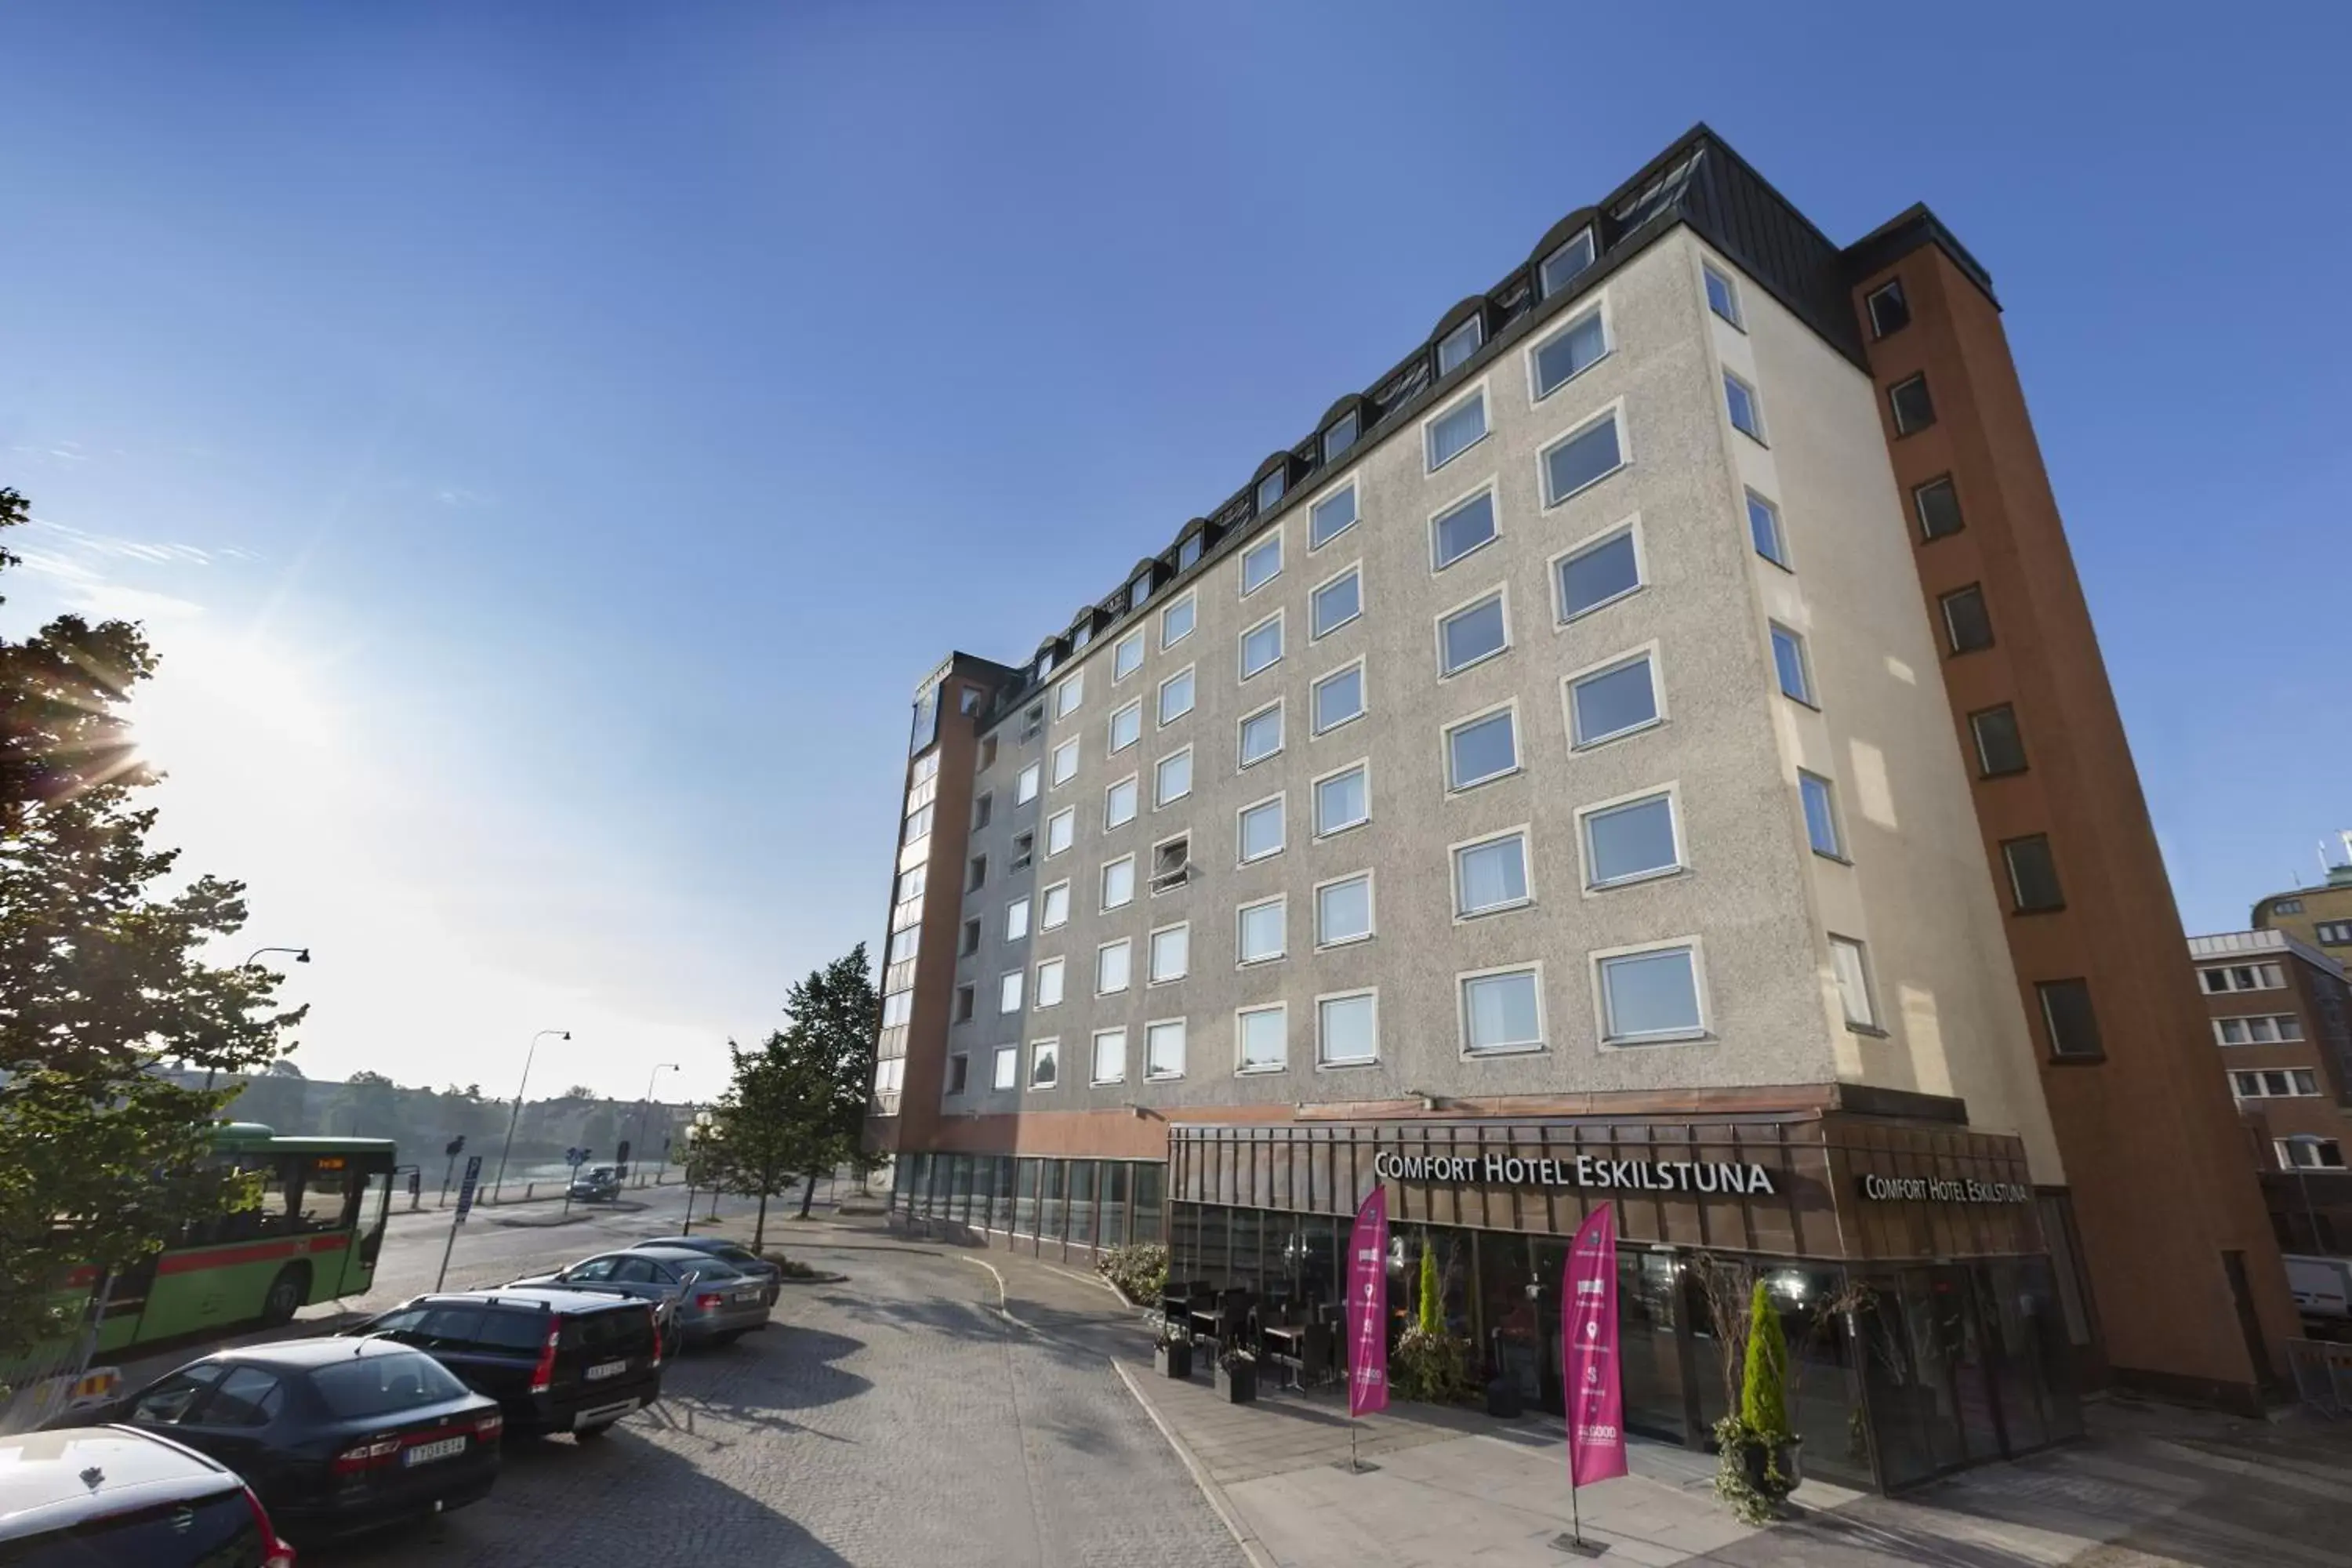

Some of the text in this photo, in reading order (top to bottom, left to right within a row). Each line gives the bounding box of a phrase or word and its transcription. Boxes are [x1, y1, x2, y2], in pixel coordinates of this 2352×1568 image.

[1374, 1152, 1775, 1194] COMFORT HOTEL ESKILSTUNA
[1865, 1174, 2029, 1203] COMFORT HOTEL ESKILSTUNA
